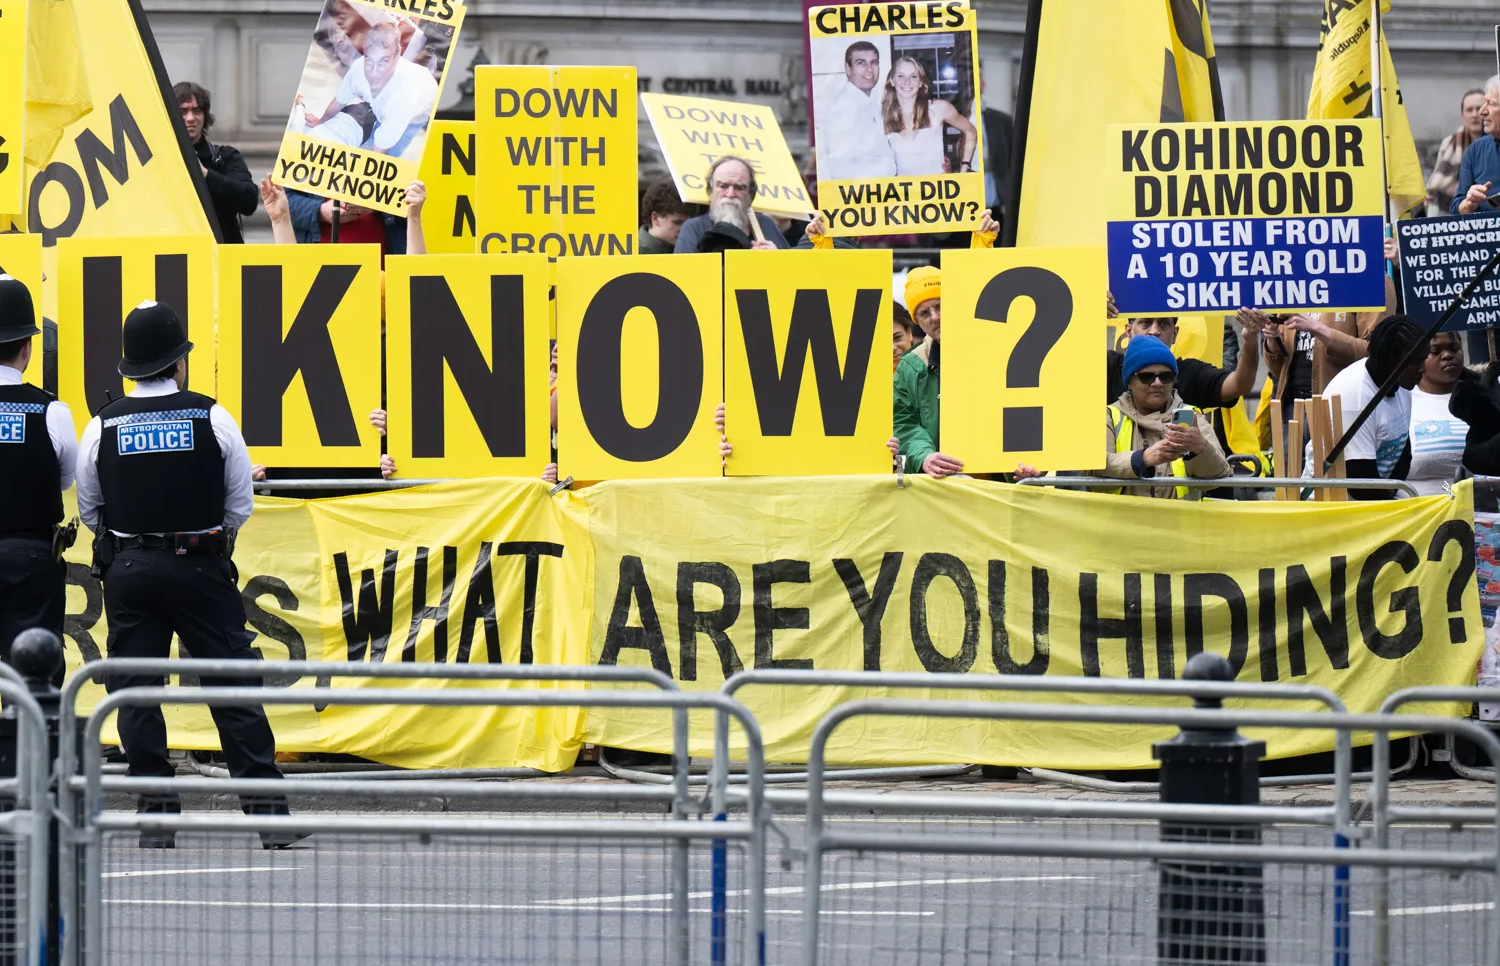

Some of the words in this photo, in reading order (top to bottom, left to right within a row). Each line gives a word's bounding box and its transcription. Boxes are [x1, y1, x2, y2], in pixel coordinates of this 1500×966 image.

[816, 1, 964, 33] CHARLES
[495, 88, 618, 118] DOWN
[663, 105, 763, 130] DOWN
[506, 137, 605, 166] WITH
[681, 129, 763, 152] WITH
[1122, 125, 1364, 171] KOHINOOR
[300, 140, 361, 173] WHAT
[364, 157, 398, 182] DID
[700, 153, 765, 175] TE
[281, 159, 323, 187] YOU
[327, 173, 407, 208] KNOW?
[682, 174, 806, 201] CWN
[839, 182, 913, 204] WHAT
[921, 180, 960, 201] DID
[1135, 172, 1353, 217] DIAMOND
[518, 185, 595, 214] THE
[822, 207, 876, 228] YOU
[885, 201, 979, 227] KNOW?
[481, 233, 632, 262] CROWN
[1132, 220, 1252, 248] STOLEN
[1266, 219, 1359, 245] FROM
[1410, 237, 1428, 249] OF
[1127, 254, 1148, 279] A
[1160, 252, 1198, 278] 10
[1210, 250, 1292, 276] YEAR
[1305, 248, 1367, 274] OLD
[1405, 254, 1427, 267] WE
[1430, 249, 1490, 265] DEMAND
[1416, 269, 1444, 282] FOR
[1450, 265, 1477, 279] THE
[1167, 282, 1241, 308] SIKH
[1254, 279, 1329, 306] KING
[1460, 295, 1500, 310] CAME
[121, 423, 190, 433] METROPOLITAN
[121, 432, 191, 452] POLICE
[333, 541, 564, 665] WHAT
[598, 554, 814, 680] ARE
[832, 551, 1050, 675] YOU
[1079, 519, 1476, 682] HIDING?
